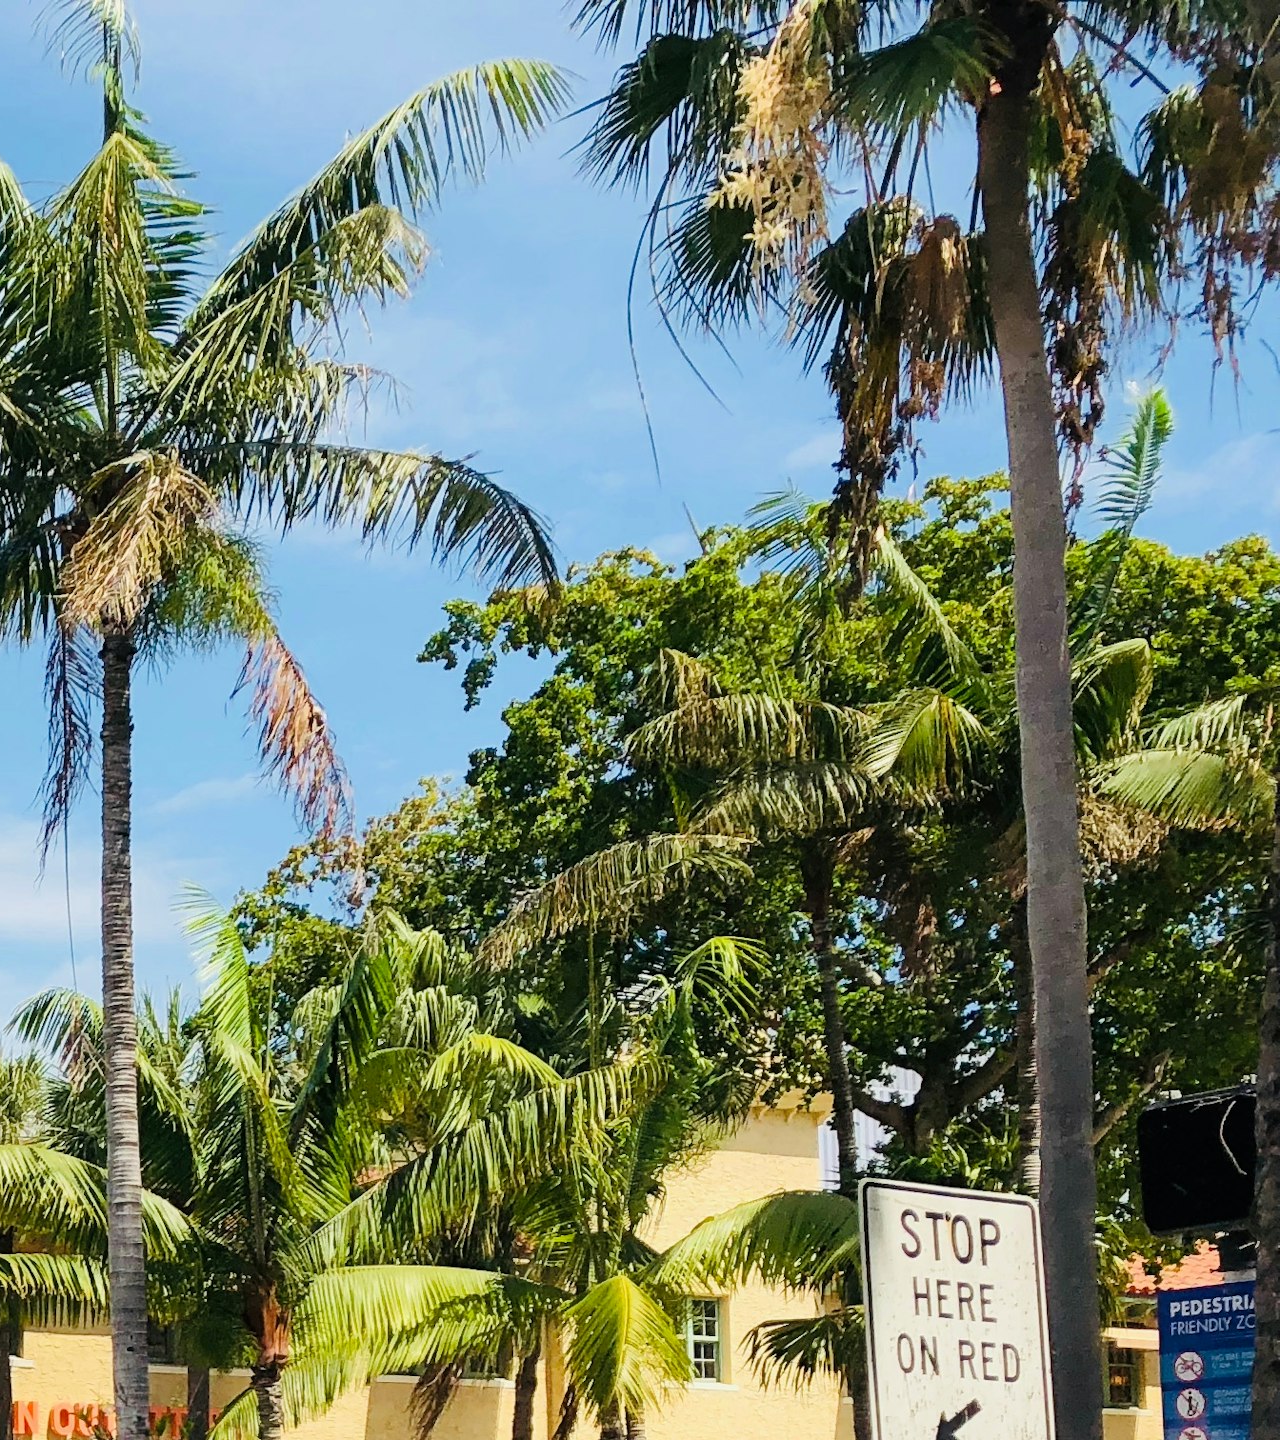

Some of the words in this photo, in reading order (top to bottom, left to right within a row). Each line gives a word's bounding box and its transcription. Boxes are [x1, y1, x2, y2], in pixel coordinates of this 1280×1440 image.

[900, 1208, 1001, 1266] STOP
[913, 1276, 998, 1323] HERE
[1170, 1316, 1232, 1336] FRIENDLY
[896, 1332, 940, 1376] ON
[958, 1339, 1021, 1383] RED
